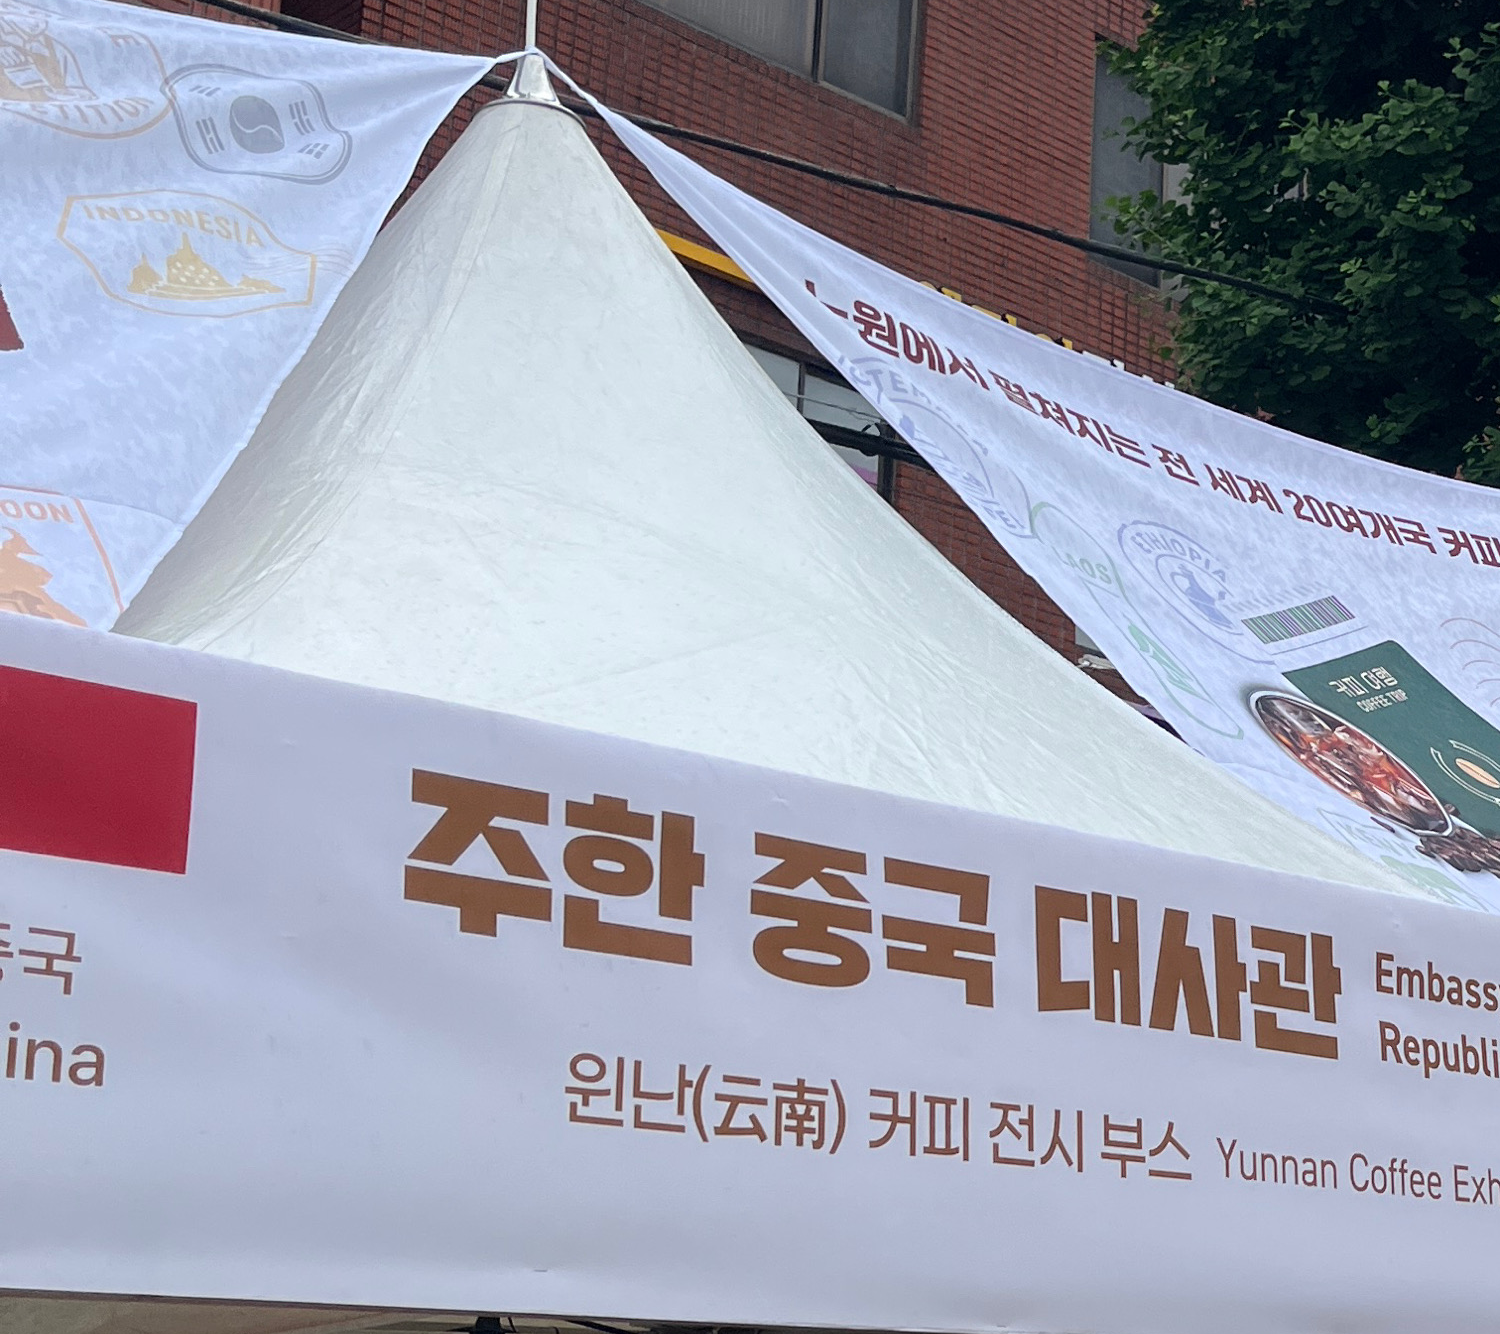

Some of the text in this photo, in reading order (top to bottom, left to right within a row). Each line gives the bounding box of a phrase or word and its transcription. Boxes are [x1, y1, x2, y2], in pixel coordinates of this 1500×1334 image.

[83, 205, 265, 248] INDONESIA
[1151, 443, 1201, 487] 전
[1203, 463, 1284, 515] 세계
[1283, 488, 1437, 554] 20여개국
[403, 767, 1342, 1061] 주한 중국 대사관
[563, 1051, 847, 1155] 윈난(云南)
[868, 1087, 970, 1163] 커피
[1216, 1136, 1338, 1189] Yunnan
[1349, 1153, 1442, 1200] Coffee
